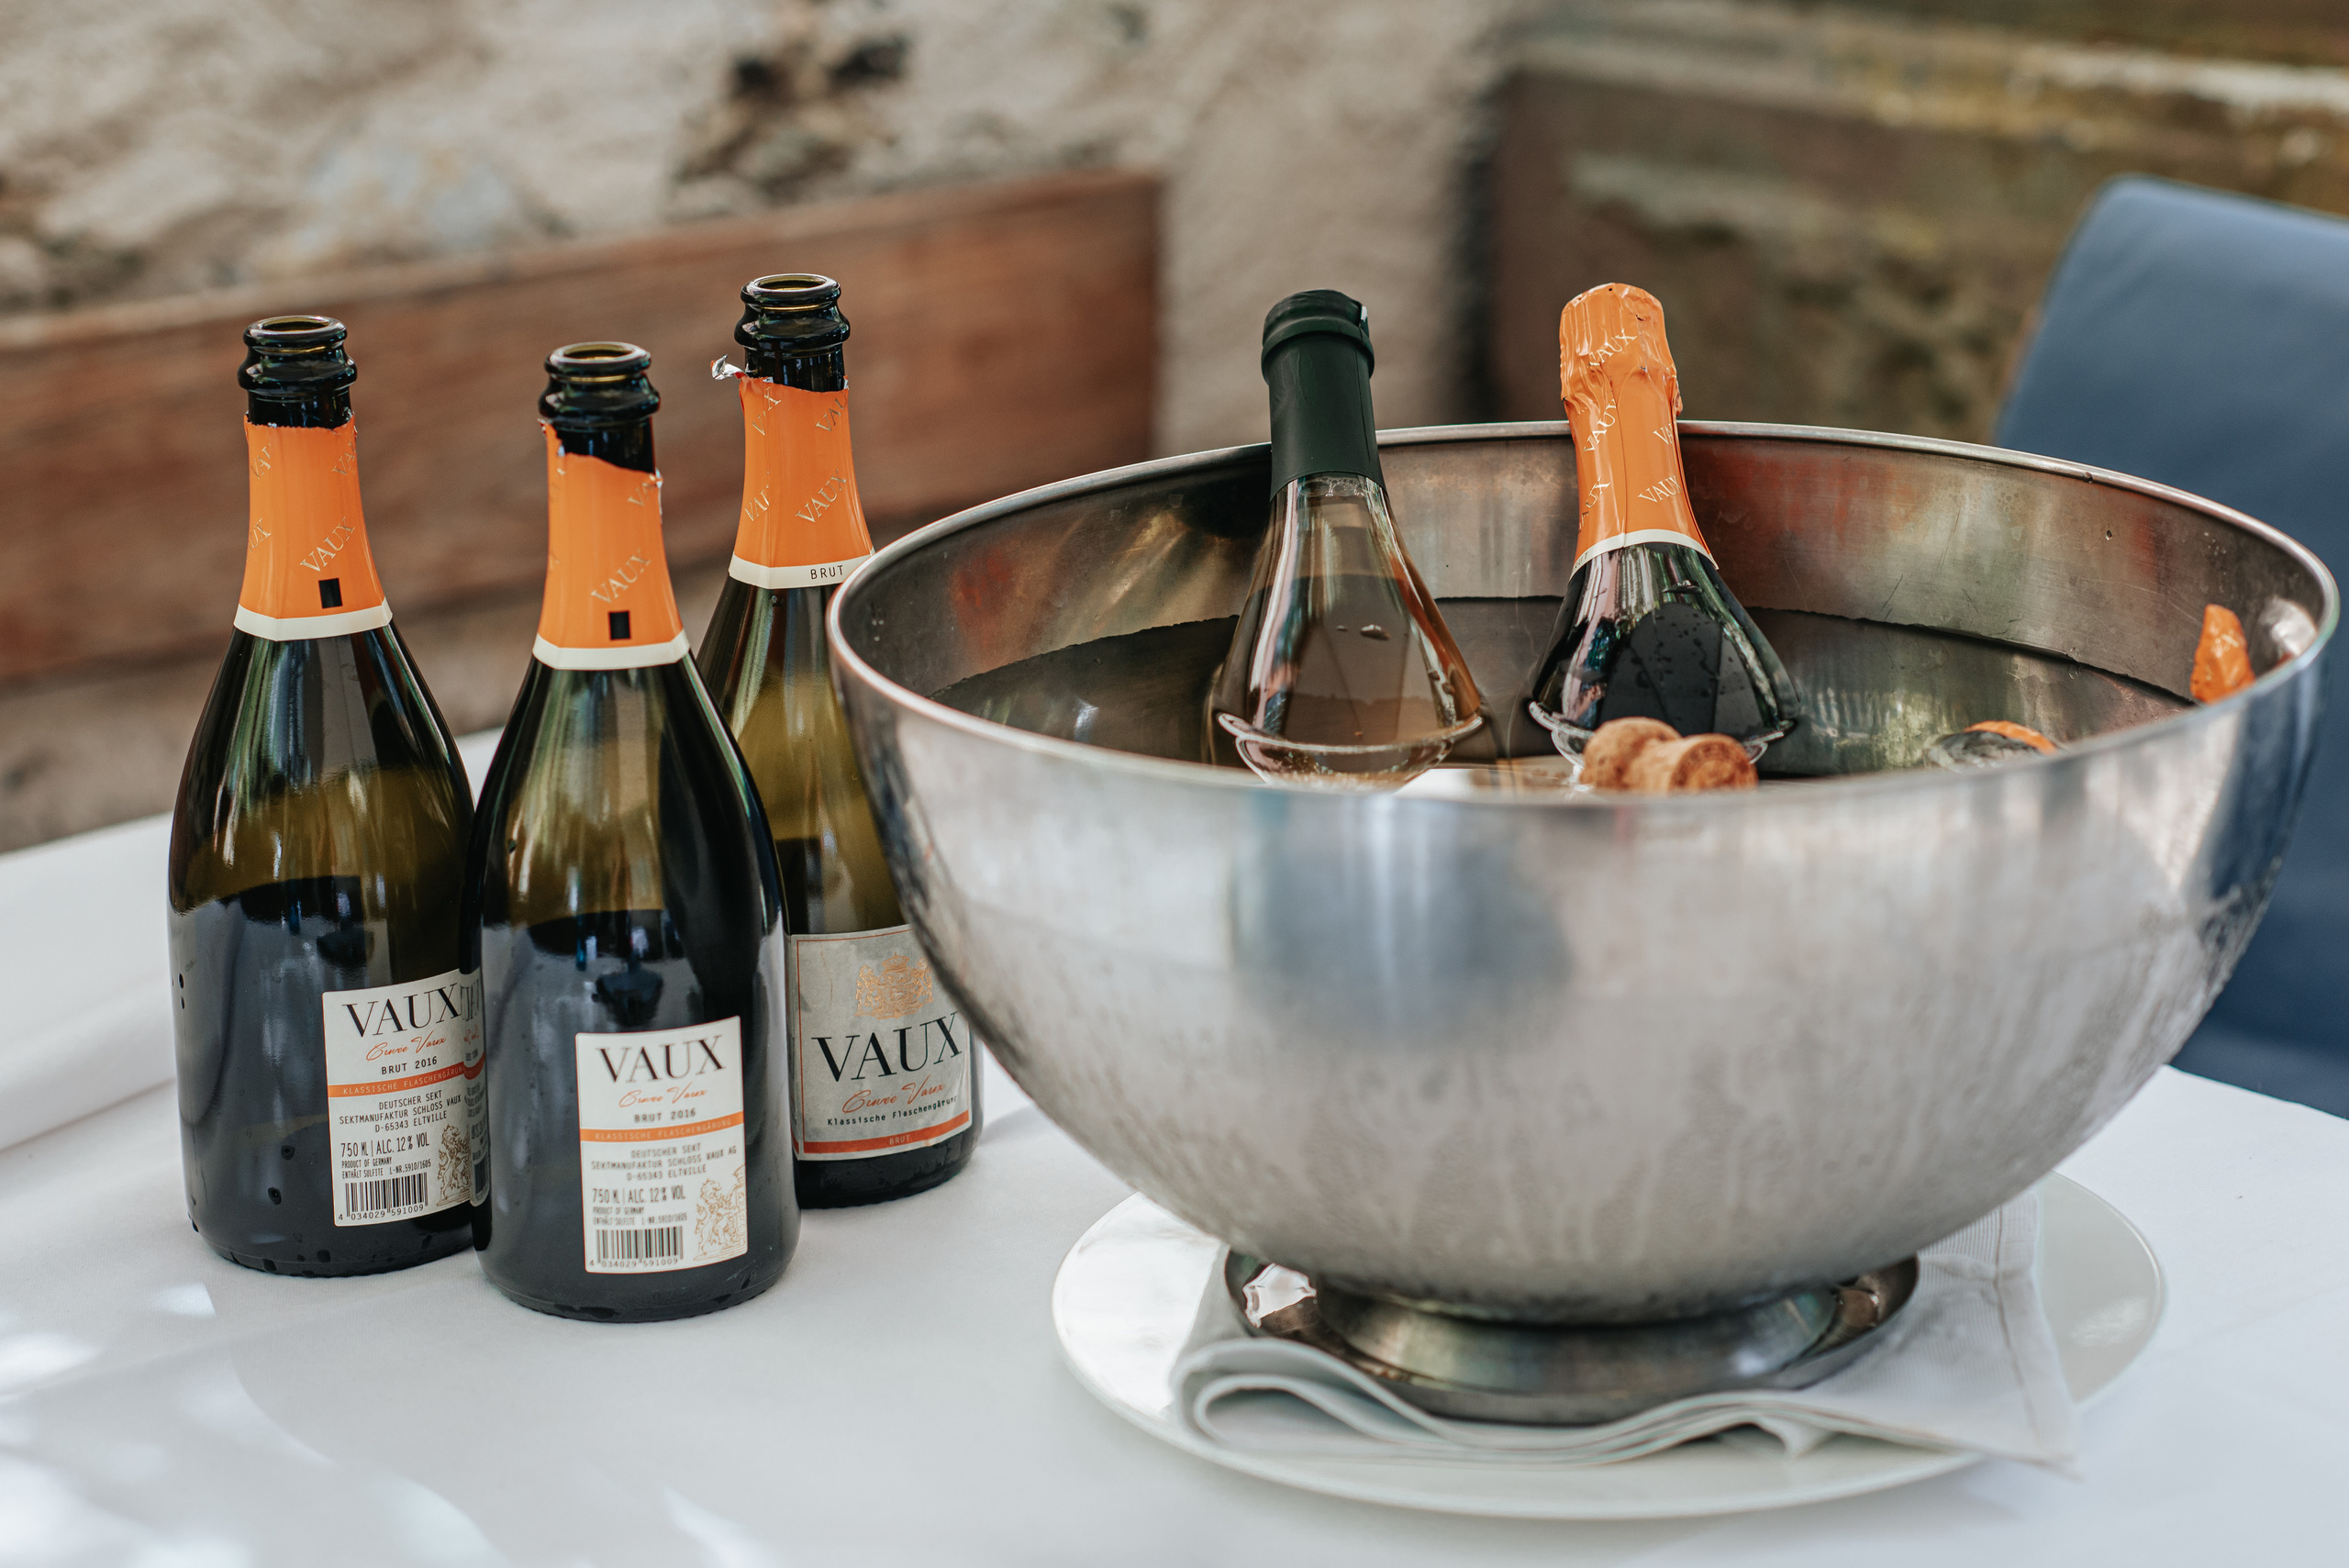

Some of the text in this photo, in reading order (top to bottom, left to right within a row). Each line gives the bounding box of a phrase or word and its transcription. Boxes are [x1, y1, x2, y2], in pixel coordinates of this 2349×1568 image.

[815, 389, 847, 432] VAU
[796, 468, 847, 523] VAUX
[1638, 475, 1684, 503] VAUX
[299, 516, 355, 573] VAUX
[590, 549, 651, 604] VAUX
[810, 565, 844, 580] BRUT
[341, 982, 462, 1038] VAUX
[366, 1042, 409, 1061] Cuvée
[411, 1030, 447, 1053] Vaux
[811, 1010, 963, 1083] VAUX
[382, 1056, 438, 1075] BRUT 2016
[596, 1035, 727, 1083] VAUX
[343, 1082, 397, 1095] KLASSISCHE
[841, 1074, 945, 1114] Cuvée Vaux
[340, 1109, 409, 1125] SEKTMANUFAKTUR
[413, 1102, 443, 1117] SCHLOSS
[447, 1095, 462, 1107] VAUX
[379, 1090, 442, 1110] DEUTSCHER SEKT
[375, 1110, 448, 1133] D-65343 ELTVILLE
[634, 1107, 696, 1123] BRUT 2016
[828, 1114, 886, 1126] Klassische
[340, 1142, 359, 1157] 750
[376, 1139, 395, 1155] ALC.
[417, 1132, 429, 1148] VOL
[596, 1130, 651, 1140] KLASSISCHE
[889, 1134, 910, 1145] BRUT
[591, 1160, 662, 1170] SEKTMANUFAKTUR
[668, 1154, 702, 1167] SCHLOSS
[729, 1145, 737, 1154] AG
[631, 1142, 701, 1159] DEUTSCHER SEKT
[341, 1156, 392, 1169] PRODUCT OF GERMANY
[668, 1163, 707, 1178] ELTVILLE
[342, 1169, 362, 1179] ENTHÄLT
[363, 1167, 384, 1178] SULFITE
[593, 1188, 610, 1203] 750
[671, 1184, 686, 1200] VOL
[351, 1210, 385, 1220] 034029
[391, 1204, 424, 1216] 591009
[601, 1260, 637, 1268] 034029
[643, 1258, 678, 1266] 591009
